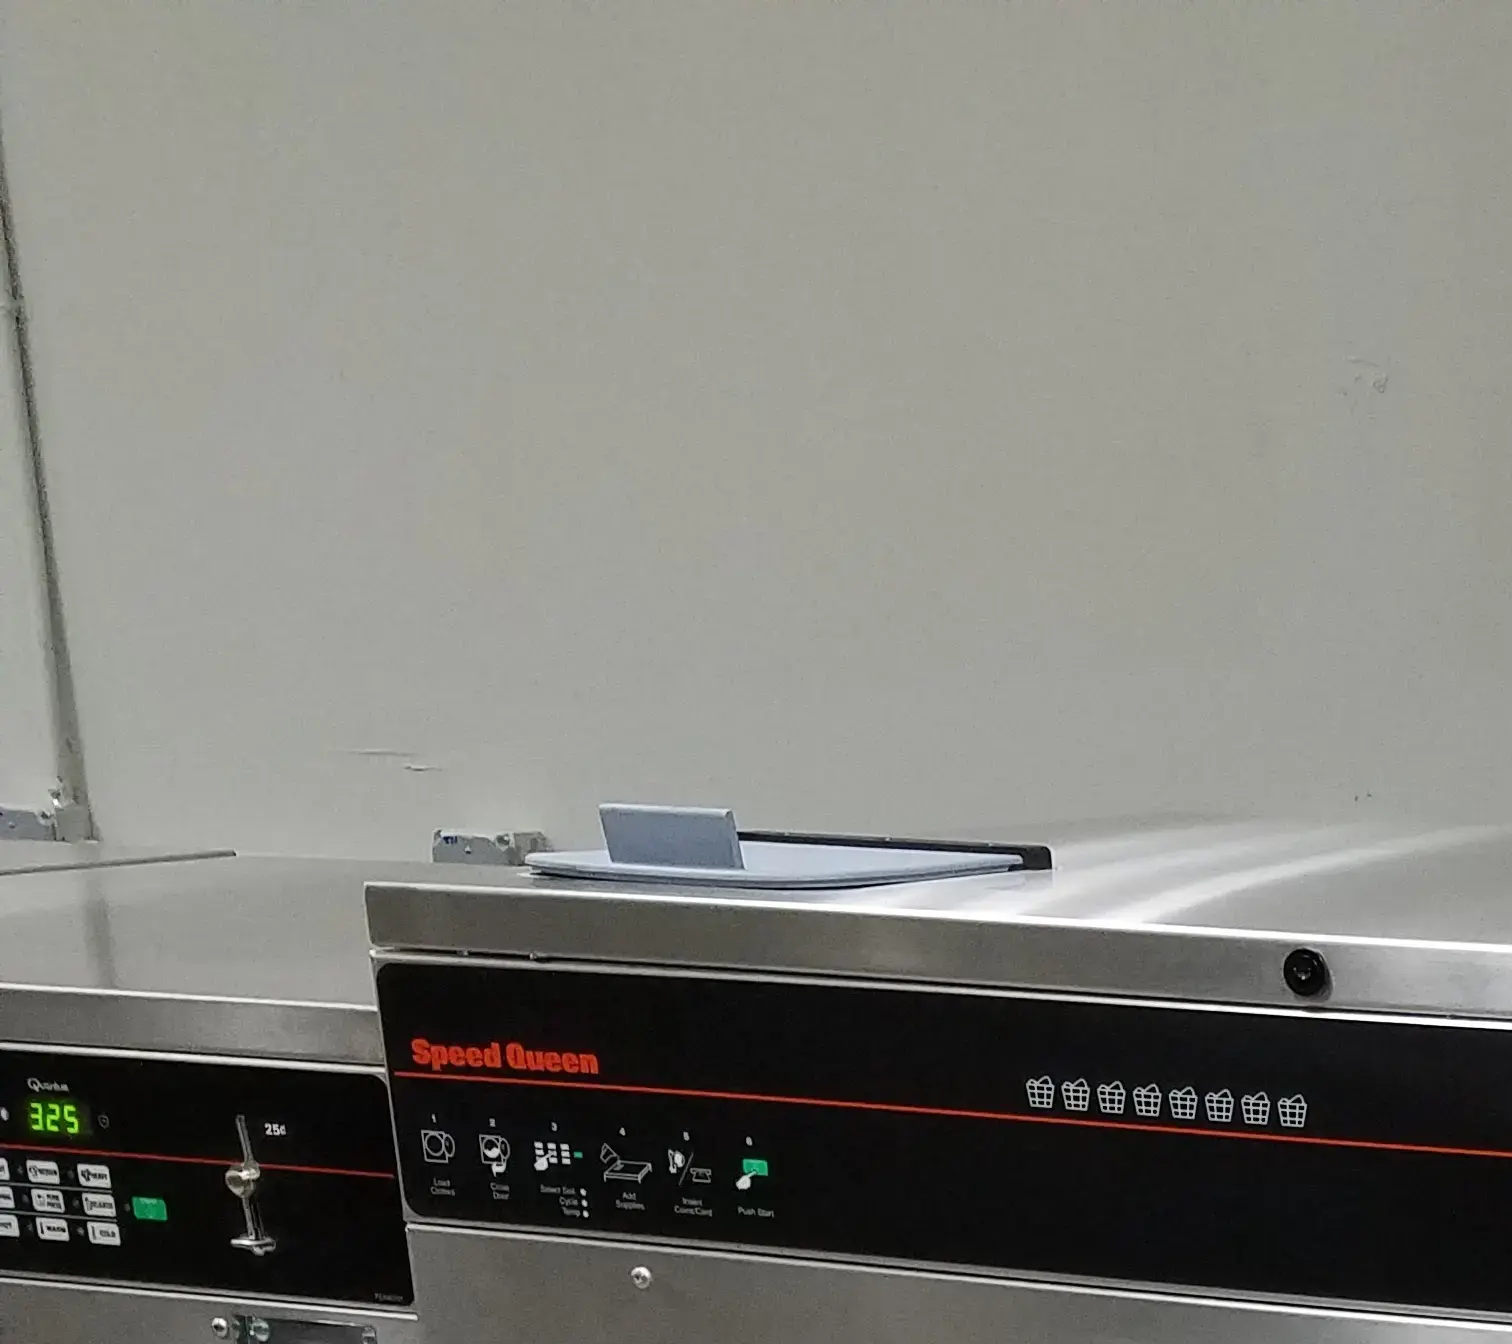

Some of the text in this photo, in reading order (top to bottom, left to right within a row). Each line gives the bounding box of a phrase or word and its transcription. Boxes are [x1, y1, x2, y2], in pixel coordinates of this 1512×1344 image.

[411, 1038, 599, 1075] Speed Queen
[30, 1102, 79, 1134] 325
[431, 1113, 437, 1123] 1
[489, 1118, 496, 1127] 2
[264, 1122, 287, 1136] 25¢
[551, 1122, 558, 1132] 3
[619, 1127, 626, 1136] 4
